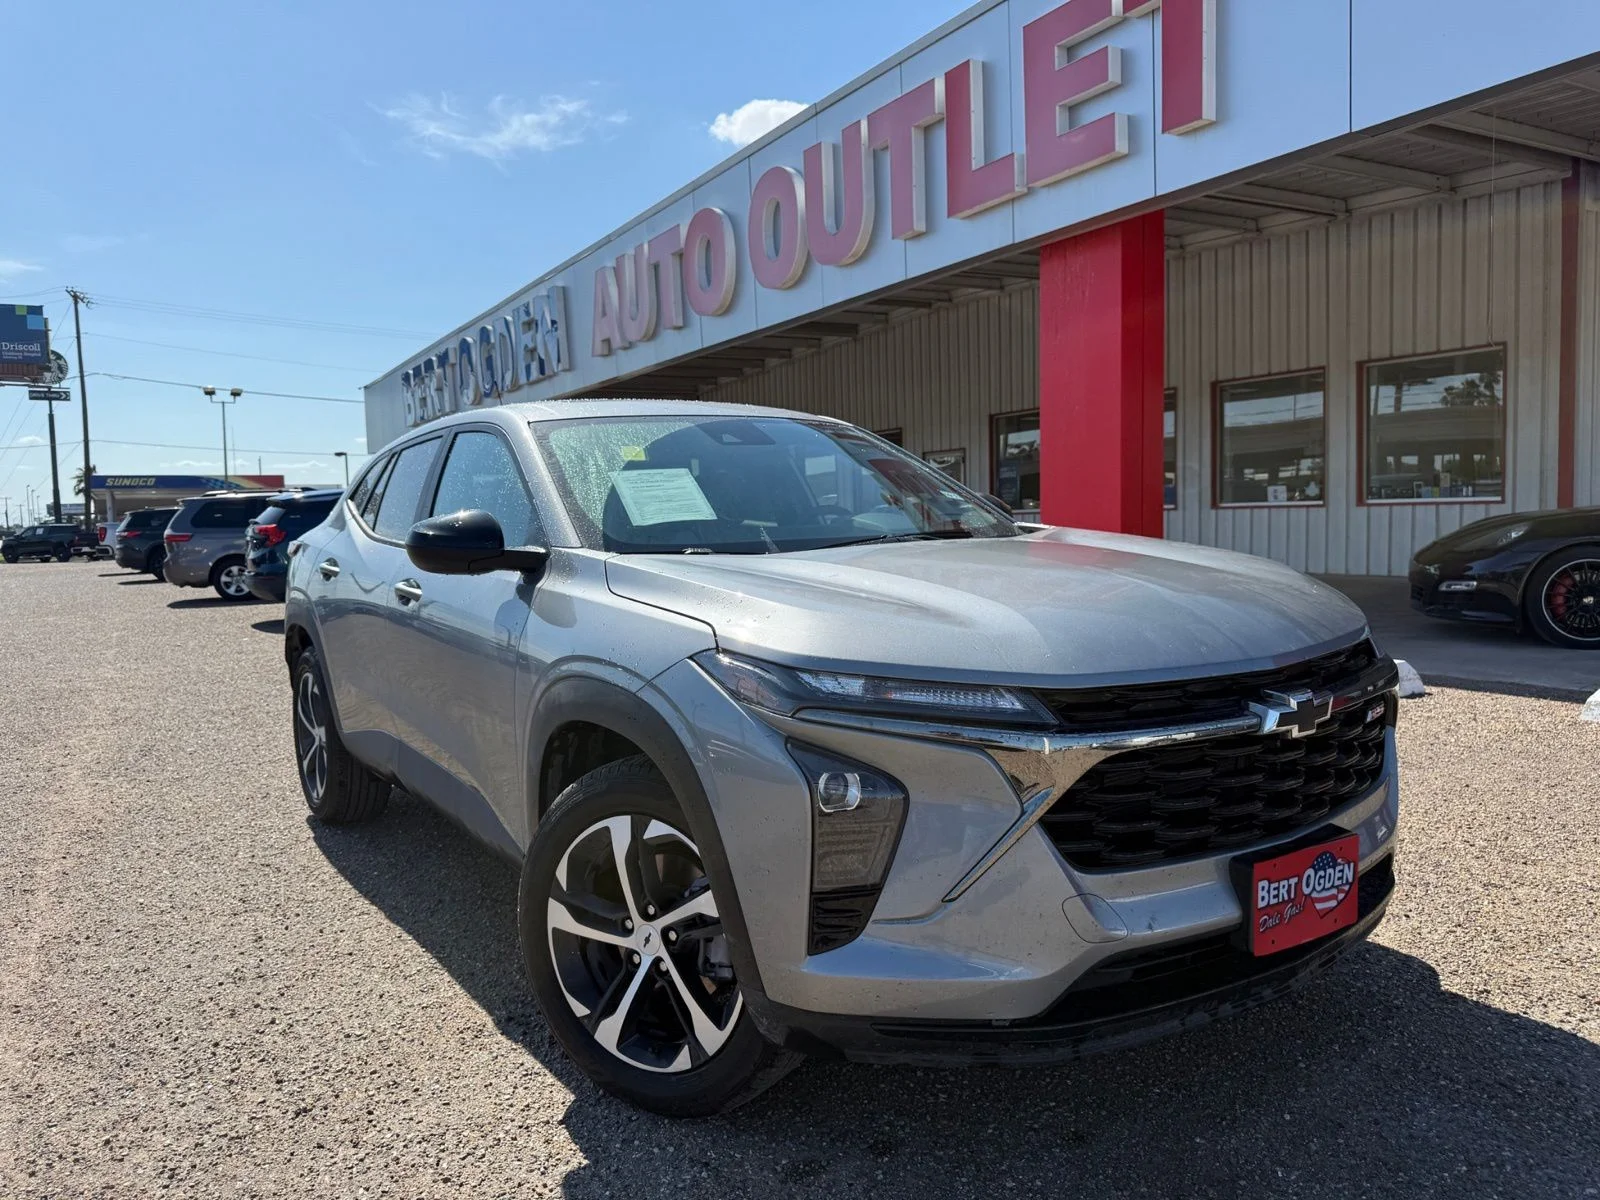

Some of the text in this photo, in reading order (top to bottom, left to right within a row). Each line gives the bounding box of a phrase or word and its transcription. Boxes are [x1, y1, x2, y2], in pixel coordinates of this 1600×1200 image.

[402, 0, 1216, 427] BERT OGDEN AUTO OUTLET
[1, 341, 41, 351] Driscoll
[105, 477, 156, 486] SUNOCO
[1257, 861, 1355, 909] BERT OGDEN
